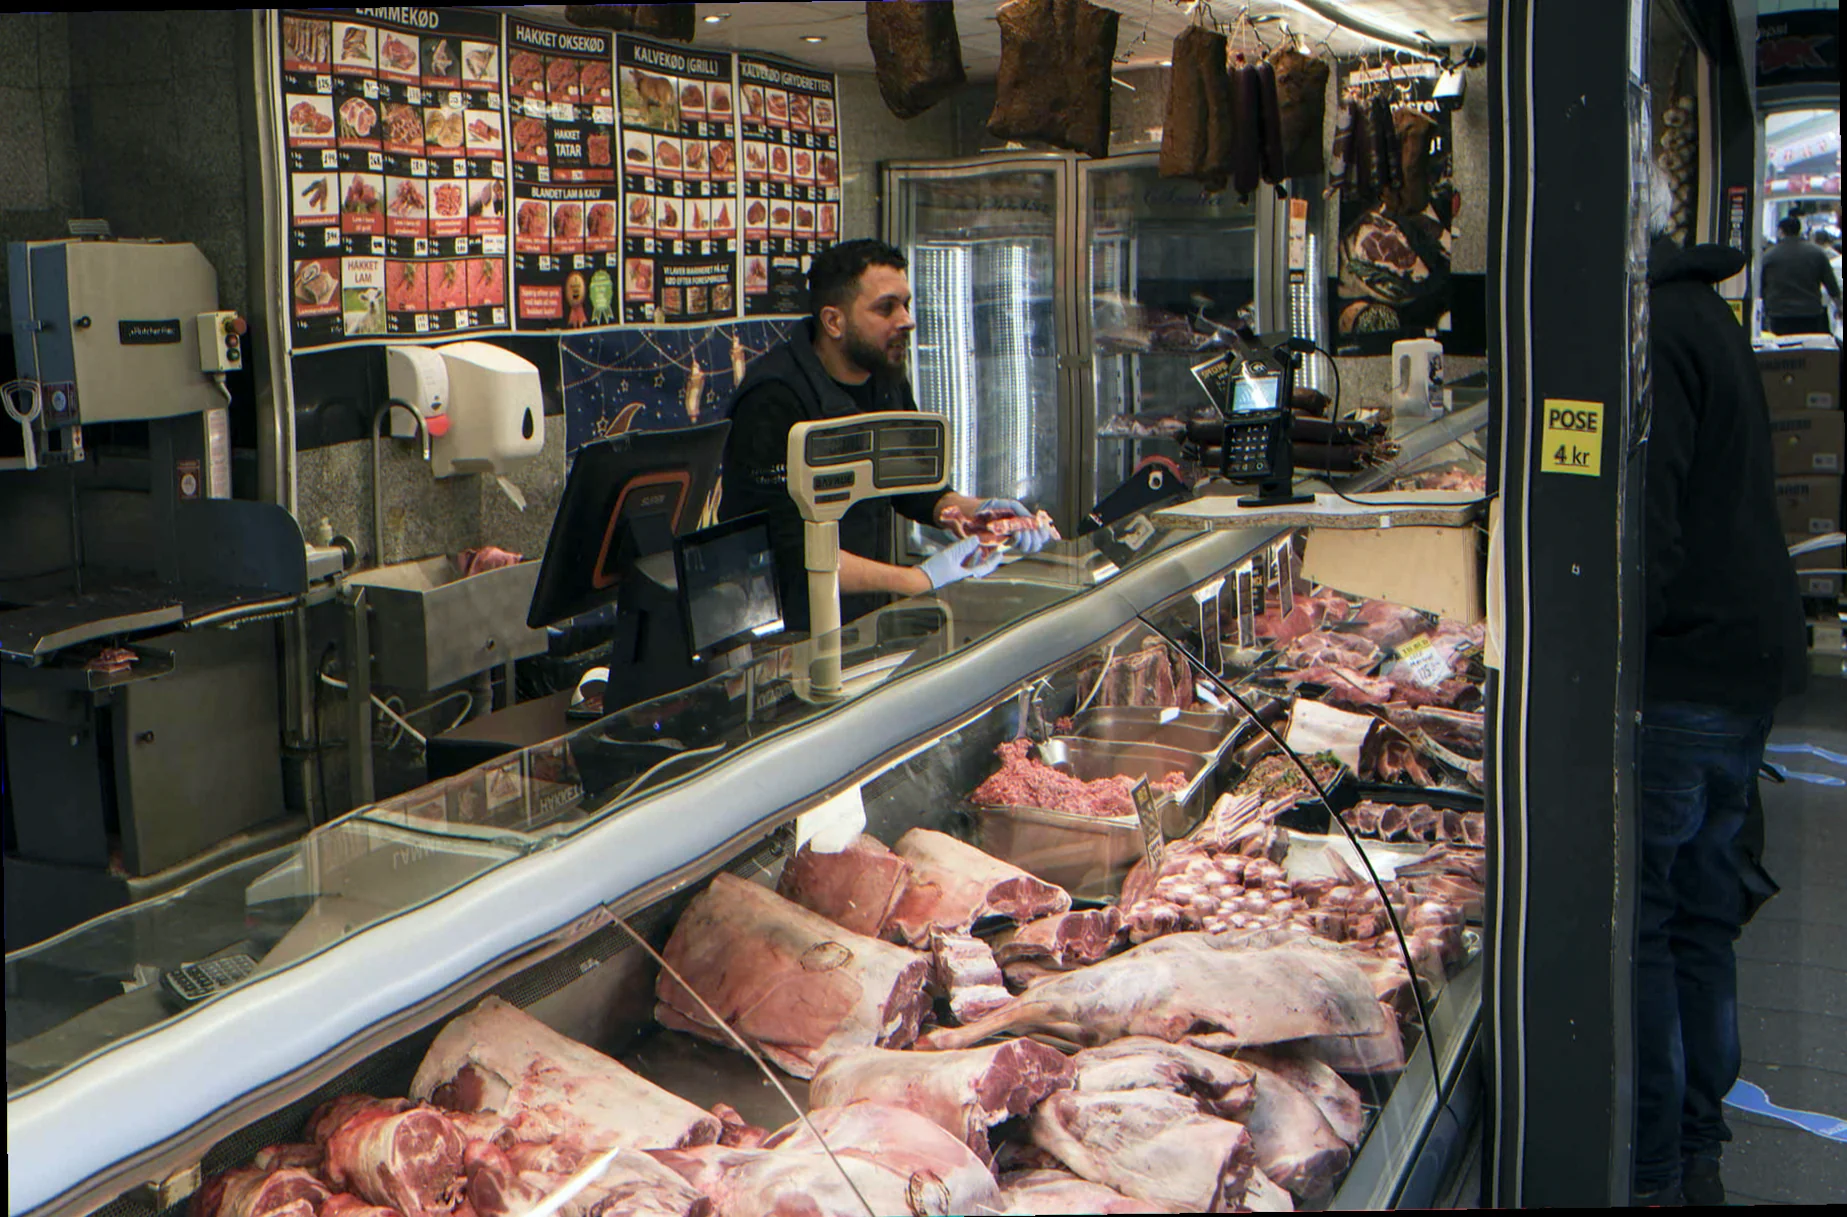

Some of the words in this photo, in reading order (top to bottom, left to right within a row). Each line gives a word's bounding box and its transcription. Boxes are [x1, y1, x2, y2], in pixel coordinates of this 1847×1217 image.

[516, 25, 557, 48] HAKKET
[559, 34, 605, 52] OKSEKØD
[634, 45, 685, 70] KALVEKØD
[687, 57, 719, 76] (GRILL)
[554, 129, 580, 140] HAKKET
[555, 143, 582, 157] TATAR
[531, 186, 562, 199] BLANDET
[563, 189, 578, 199] LAM
[584, 188, 601, 199] KALV
[347, 260, 379, 271] HAKKET
[354, 273, 373, 283] LAM
[1549, 409, 1598, 430] POSE
[1554, 444, 1567, 463] 4
[1573, 445, 1590, 465] kr
